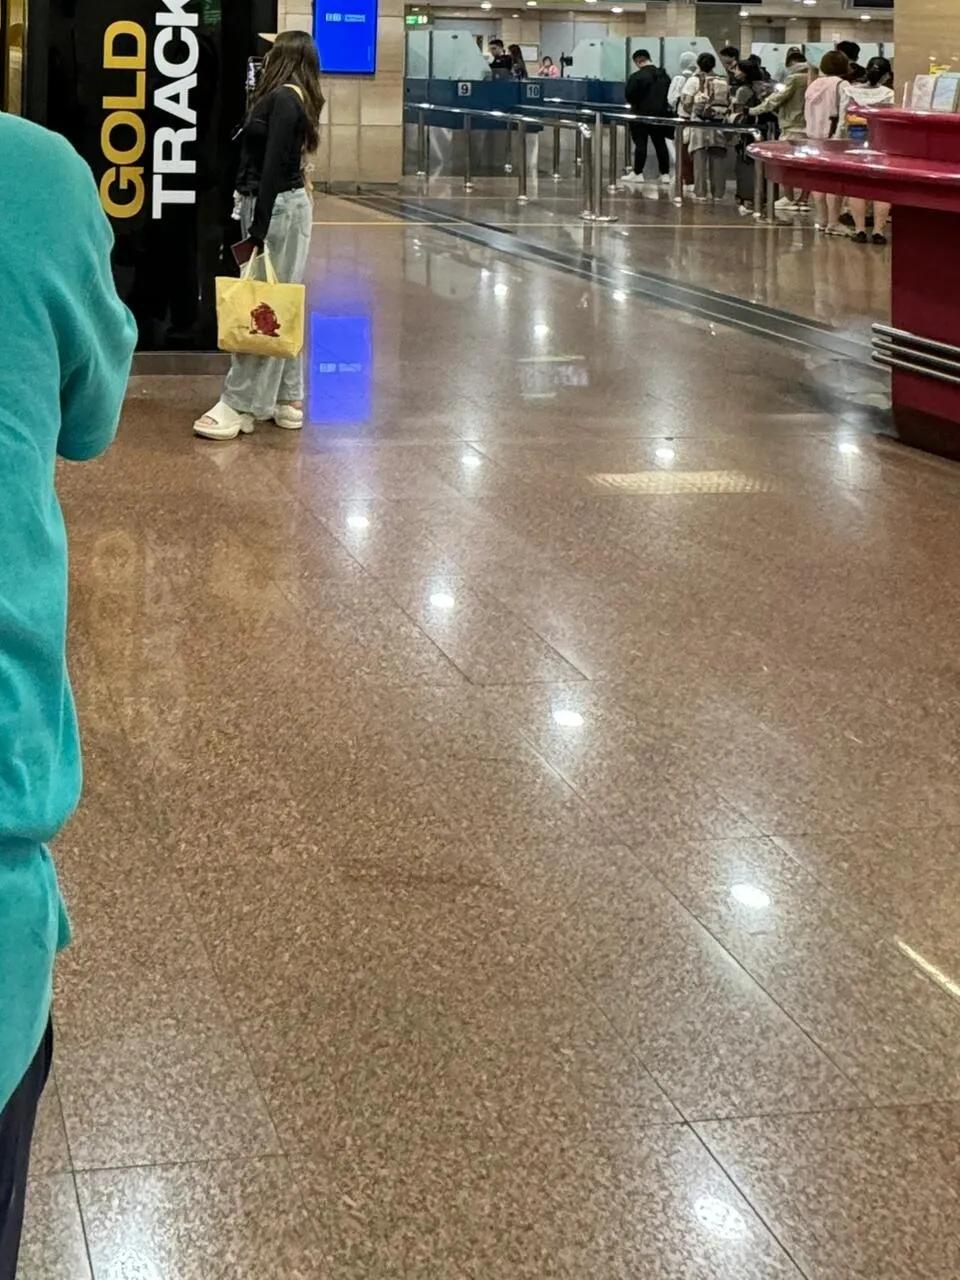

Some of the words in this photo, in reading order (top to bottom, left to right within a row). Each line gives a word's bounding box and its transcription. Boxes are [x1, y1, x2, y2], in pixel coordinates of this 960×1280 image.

[460, 83, 469, 95] 9
[528, 86, 539, 96] 10
[99, 20, 147, 218] GOLD
